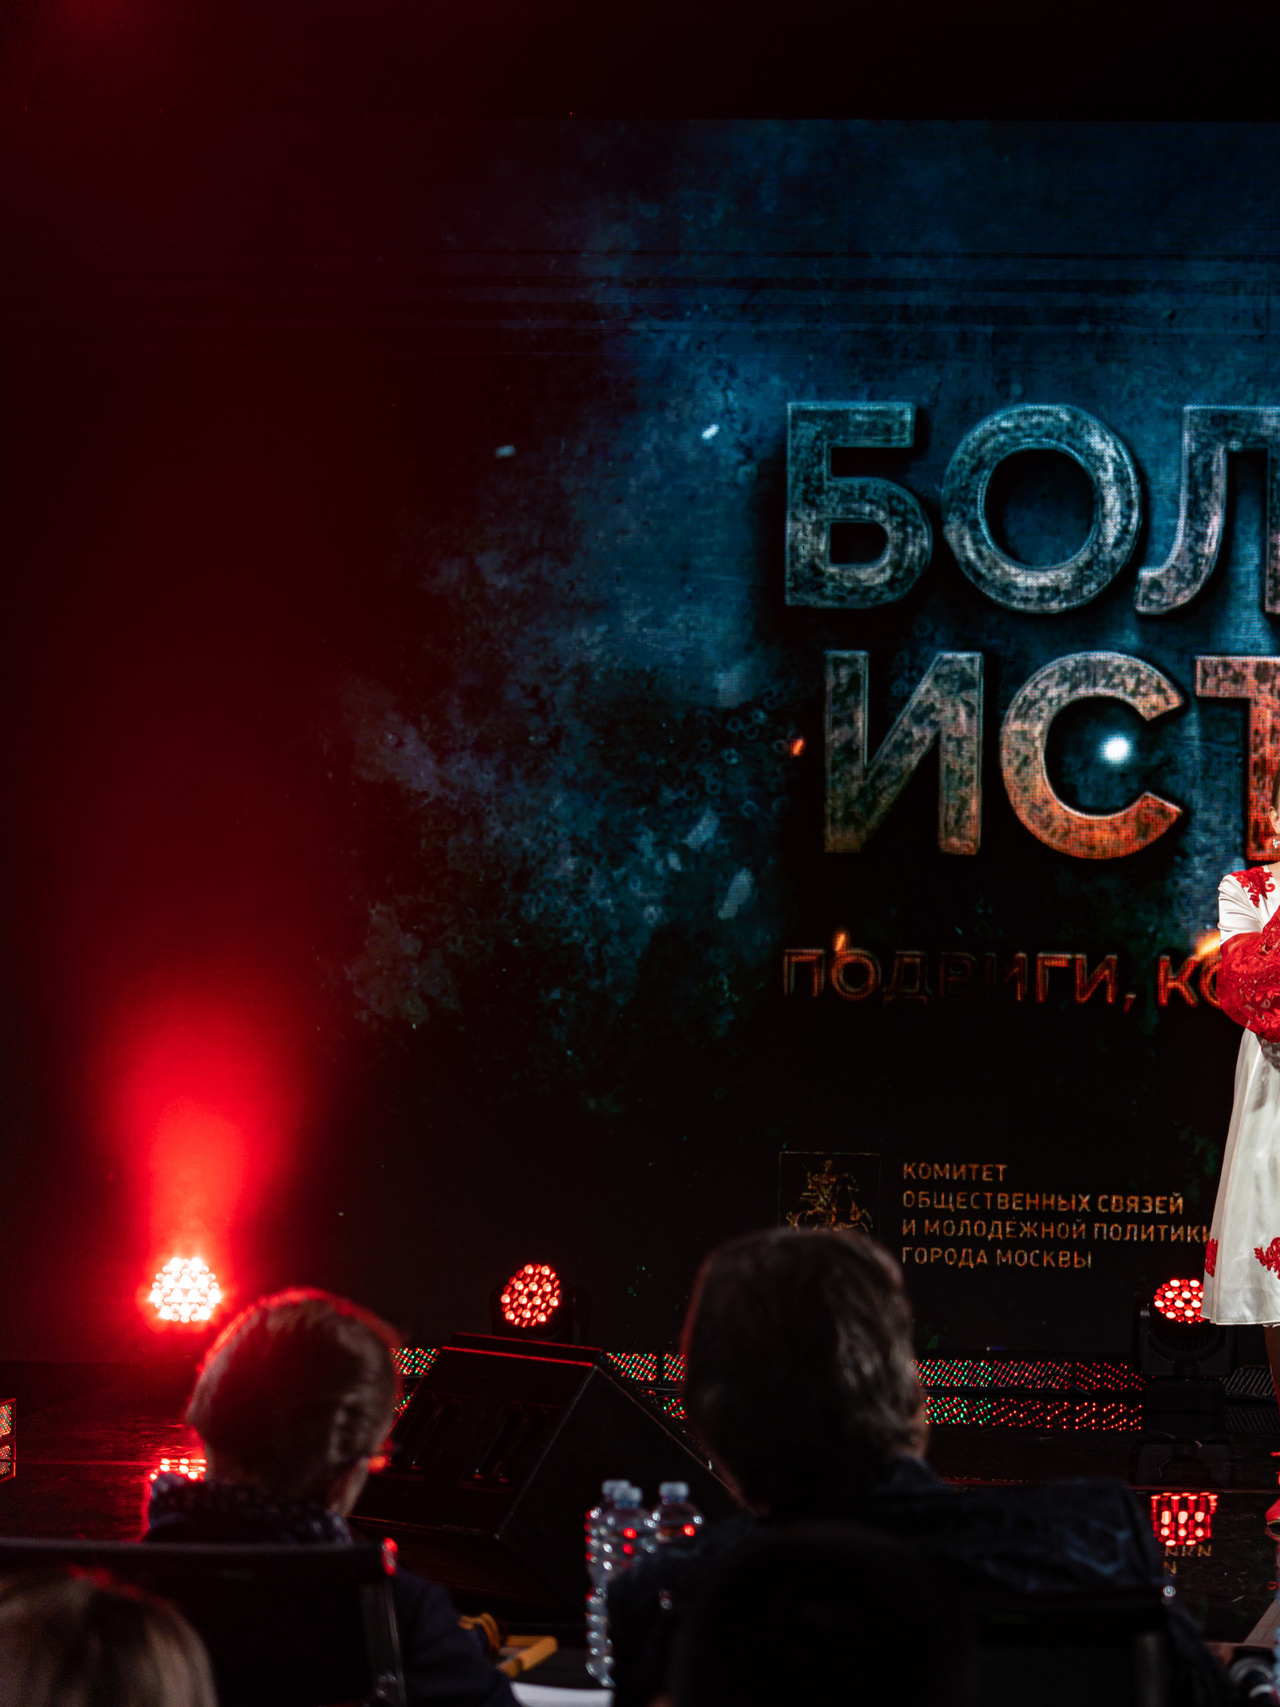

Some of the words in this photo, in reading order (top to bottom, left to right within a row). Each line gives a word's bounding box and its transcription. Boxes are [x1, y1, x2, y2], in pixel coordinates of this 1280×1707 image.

[782, 947, 1137, 1013] ПОДВИГИ,
[902, 1162, 1008, 1181] КОМИТЕТ
[902, 1190, 1092, 1213] ОБЩЕСТВЕННЫХ
[1097, 1191, 1184, 1215] СВЯЗЕЙ
[902, 1218, 916, 1236] И
[902, 1246, 988, 1269] ГОРОДА
[996, 1248, 1092, 1269] МОСКВЫ
